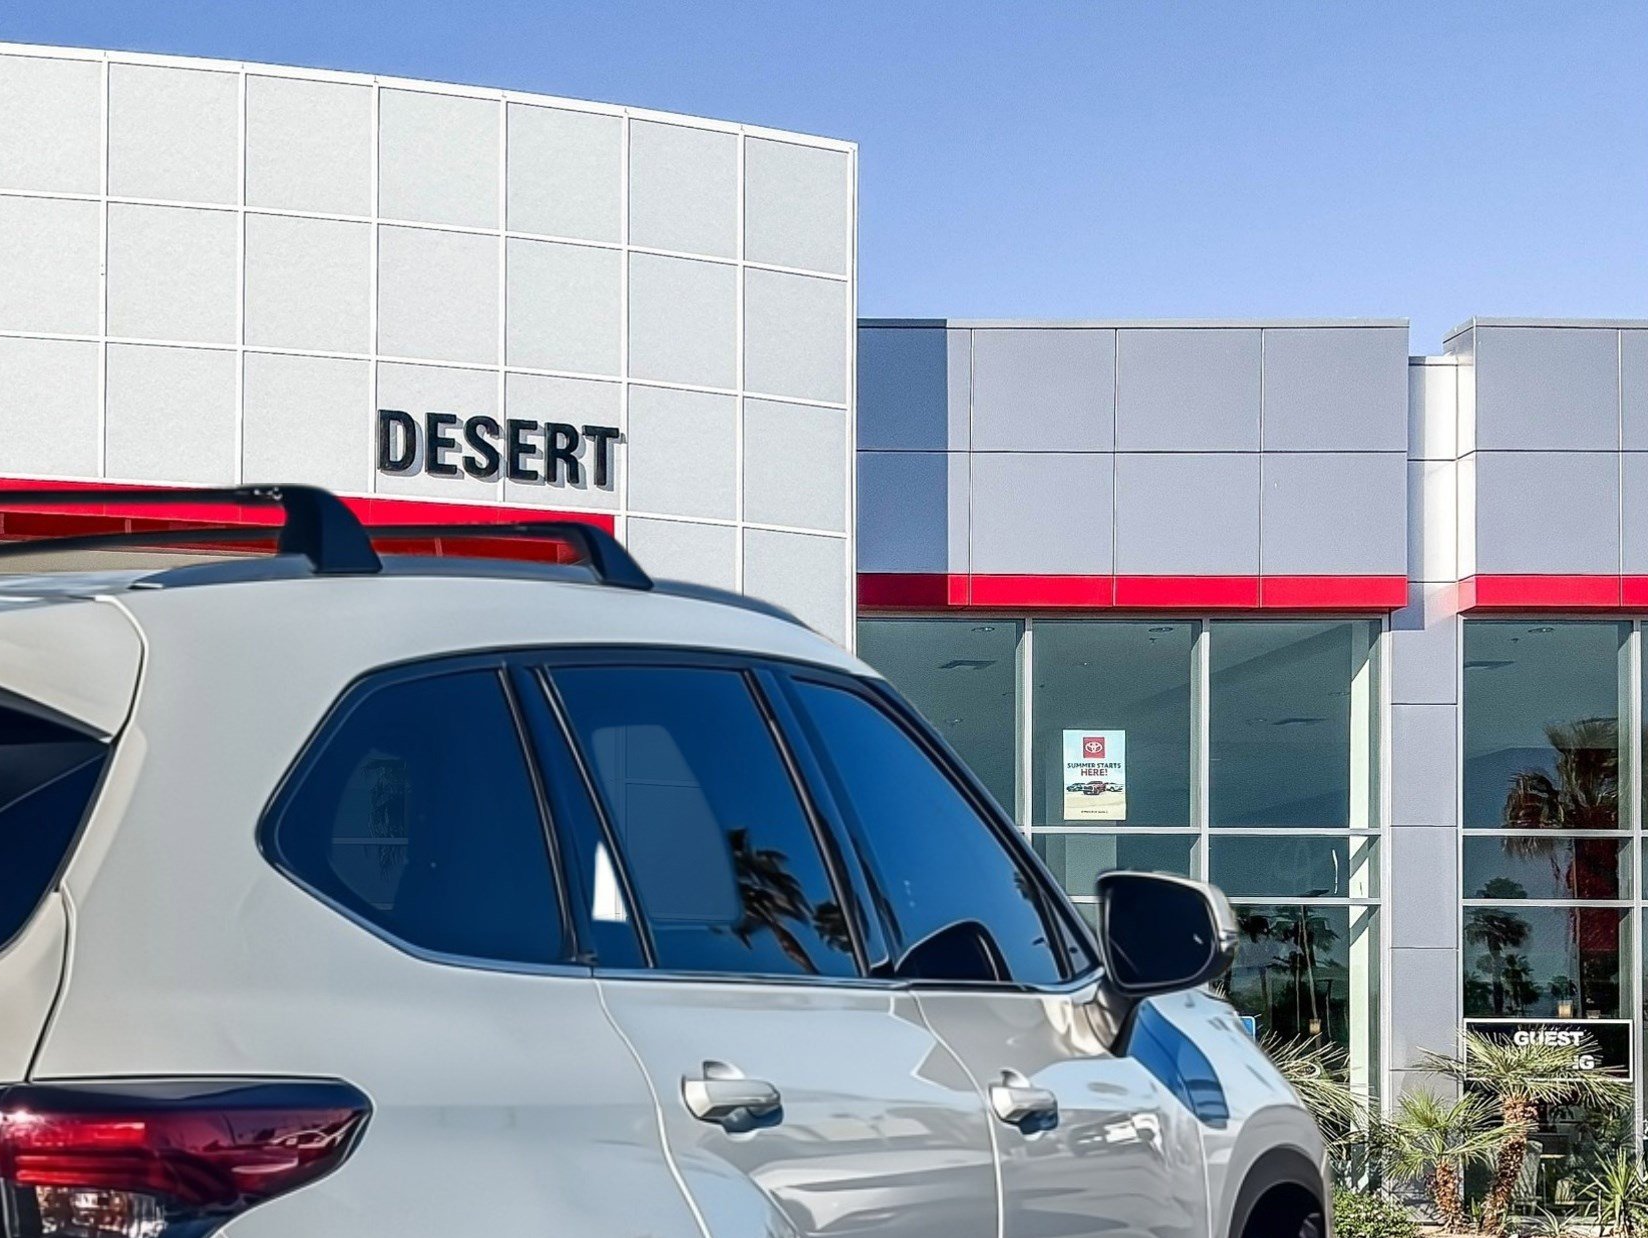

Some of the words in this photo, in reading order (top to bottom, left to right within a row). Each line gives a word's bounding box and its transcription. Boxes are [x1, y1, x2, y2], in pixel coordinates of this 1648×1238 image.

[377, 409, 621, 487] DESERT
[1080, 768, 1108, 777] HERE!
[1513, 1031, 1584, 1047] GUEST
